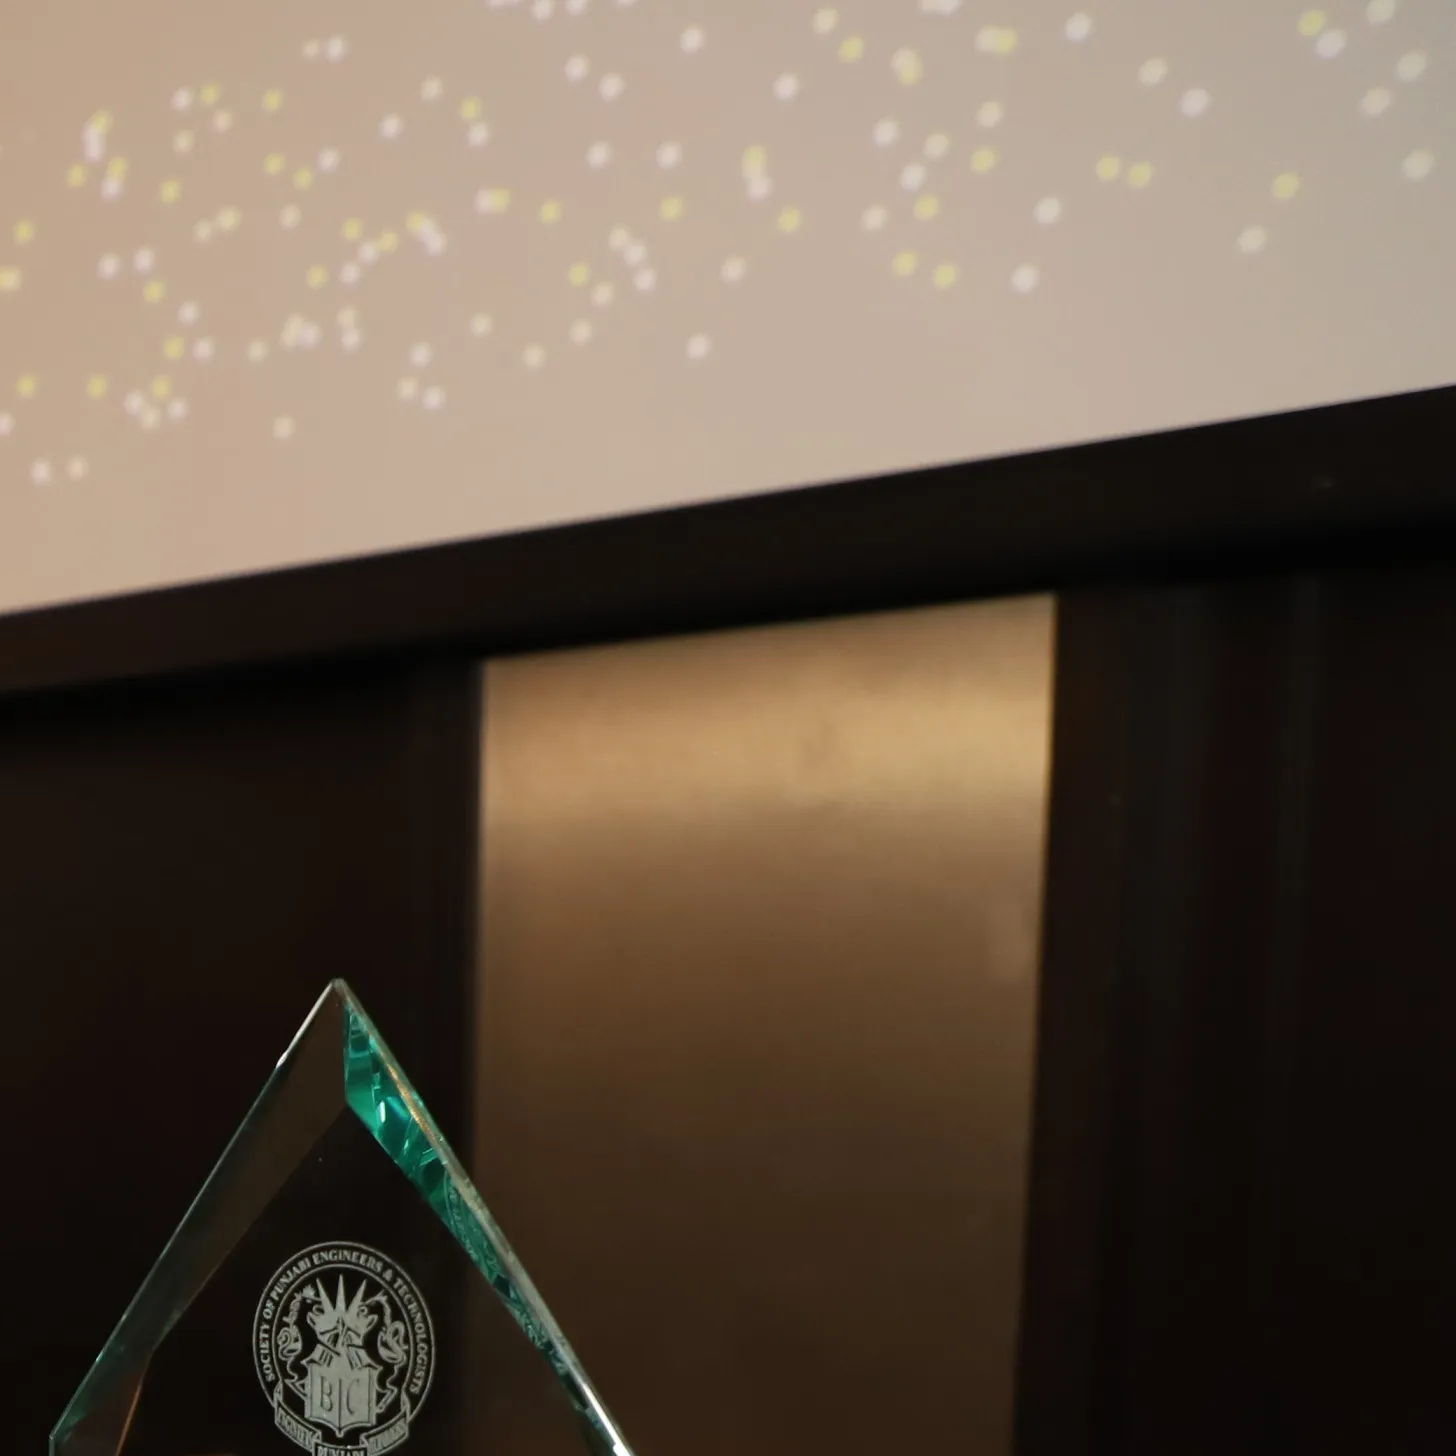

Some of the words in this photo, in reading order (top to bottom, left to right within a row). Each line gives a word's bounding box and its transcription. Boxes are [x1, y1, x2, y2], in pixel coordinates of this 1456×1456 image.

[271, 1257, 311, 1300] PUNJABI
[311, 1248, 384, 1273] ENGINEERS
[262, 1299, 275, 1320] OF
[259, 1323, 275, 1382] SOCIETY
[392, 1277, 428, 1394] TECHNOLOGISTS
